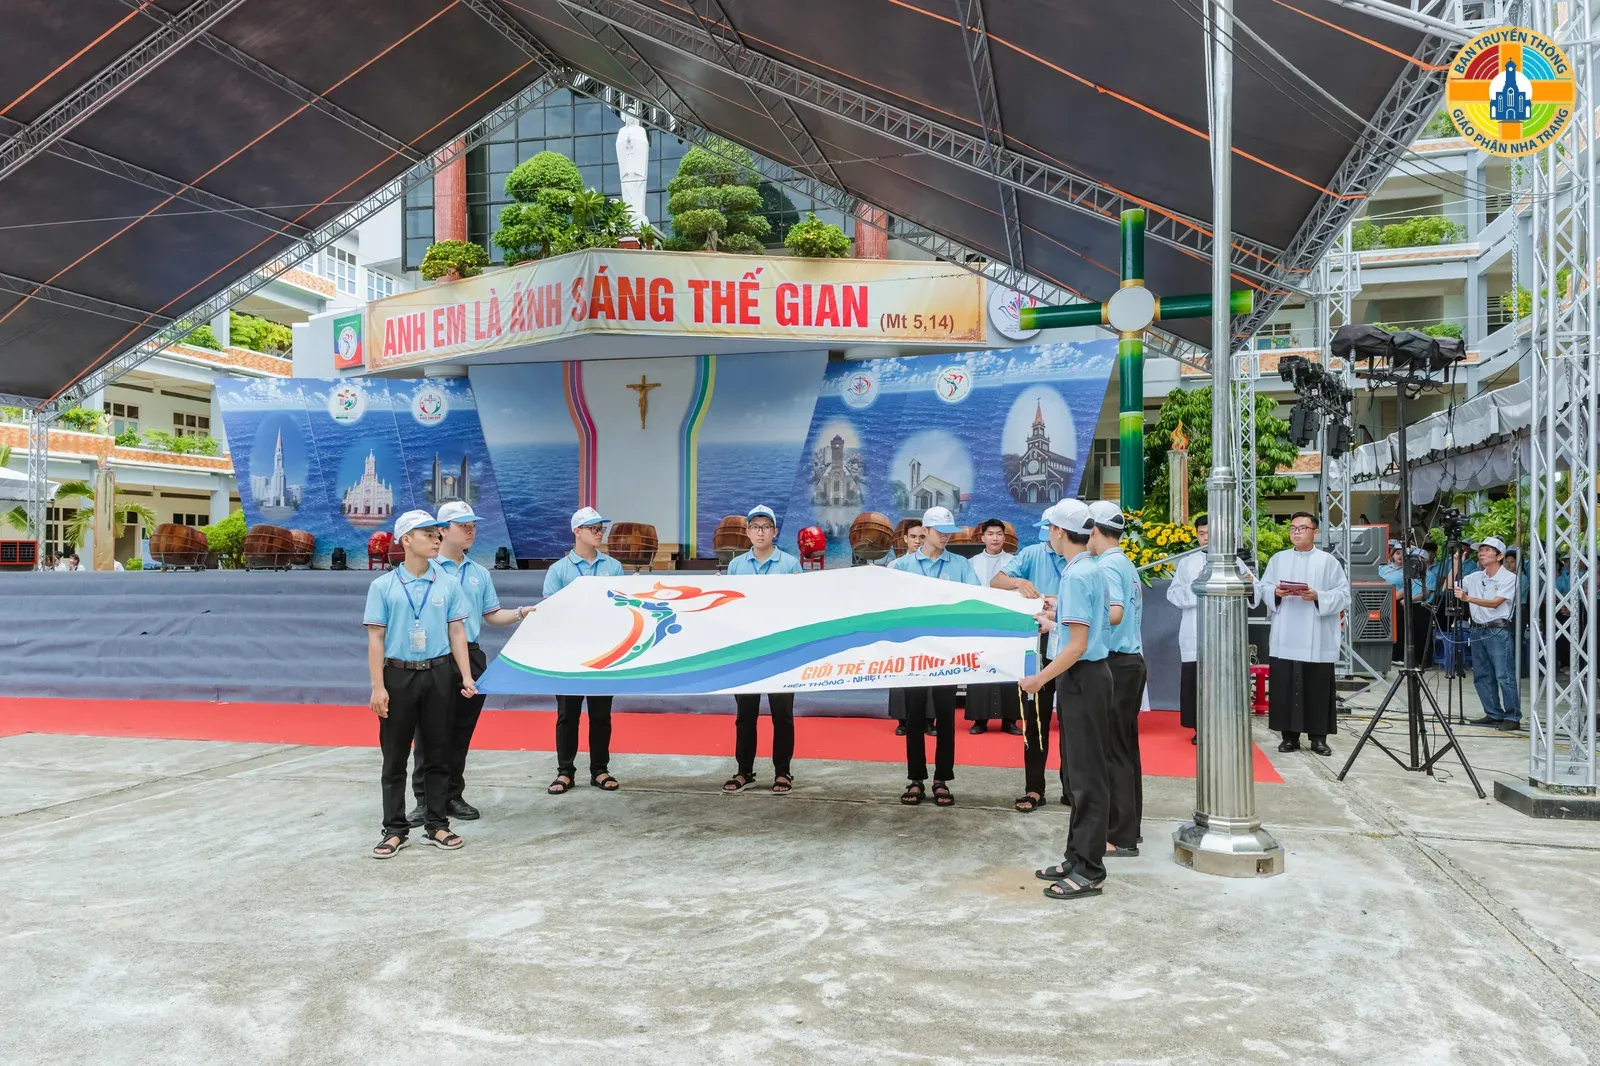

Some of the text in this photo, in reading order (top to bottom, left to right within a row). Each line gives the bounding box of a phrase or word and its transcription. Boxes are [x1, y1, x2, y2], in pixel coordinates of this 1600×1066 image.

[383, 265, 955, 359] ANH EM LÀ ÁNH SÁNG THẾ GIAN (Mt 5,14)
[801, 662, 834, 681] GIỚI
[867, 655, 905, 675] GIÁO
